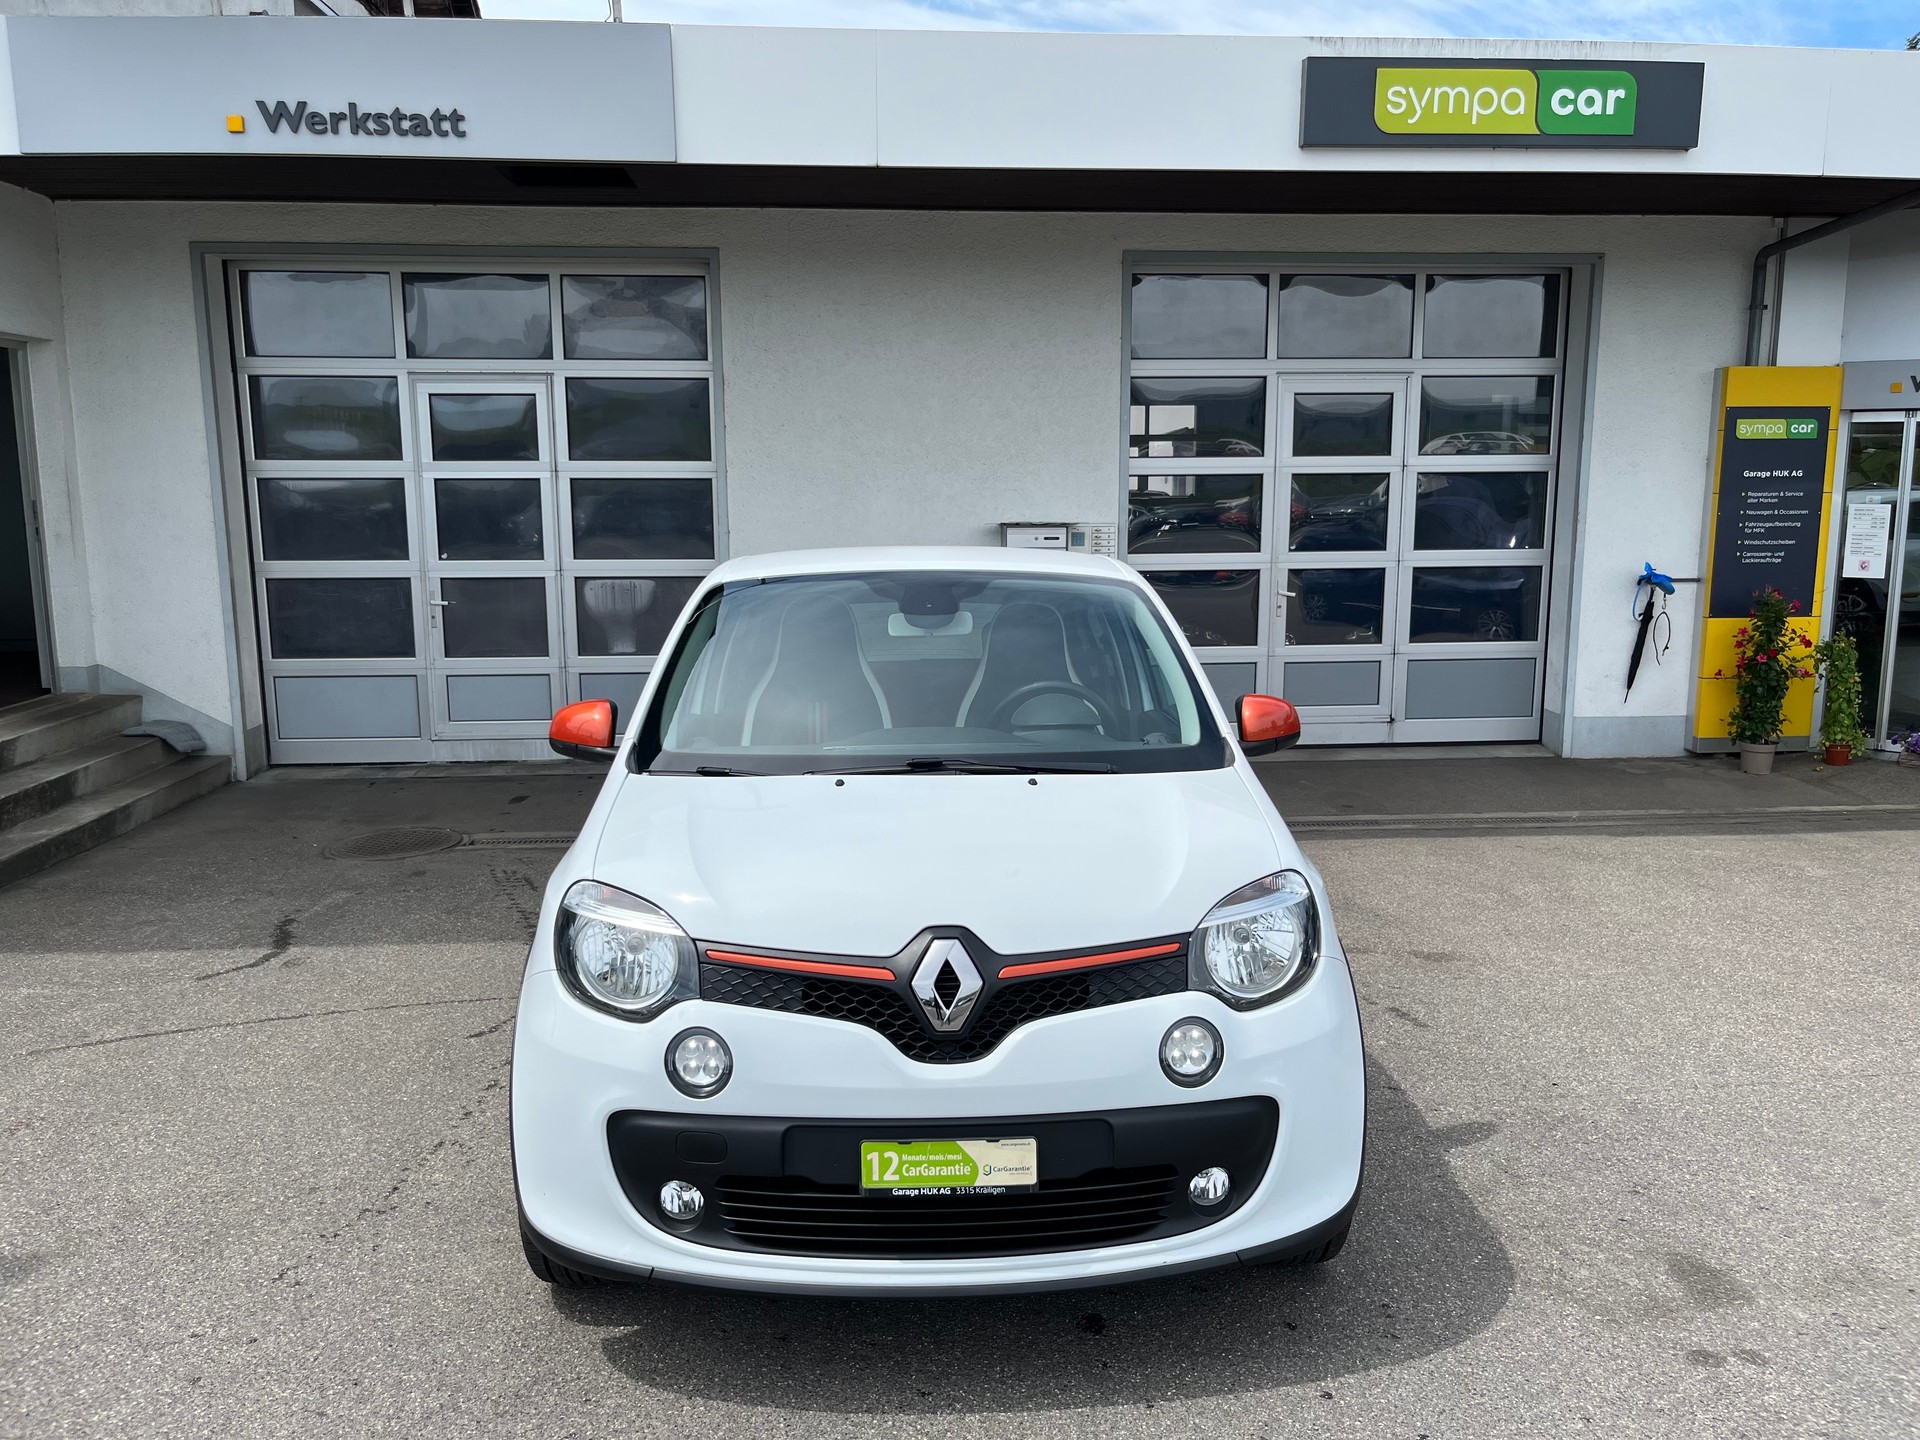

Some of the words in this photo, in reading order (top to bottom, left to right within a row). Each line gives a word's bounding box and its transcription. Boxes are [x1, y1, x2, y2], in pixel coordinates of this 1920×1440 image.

[255, 100, 467, 137] Werkstatt
[1386, 86, 1525, 125] sympa
[1550, 88, 1625, 115] car
[1739, 424, 1784, 437] sympa
[1790, 424, 1815, 433] car
[866, 1151, 900, 1182] 12
[892, 1188, 919, 1196] Garage
